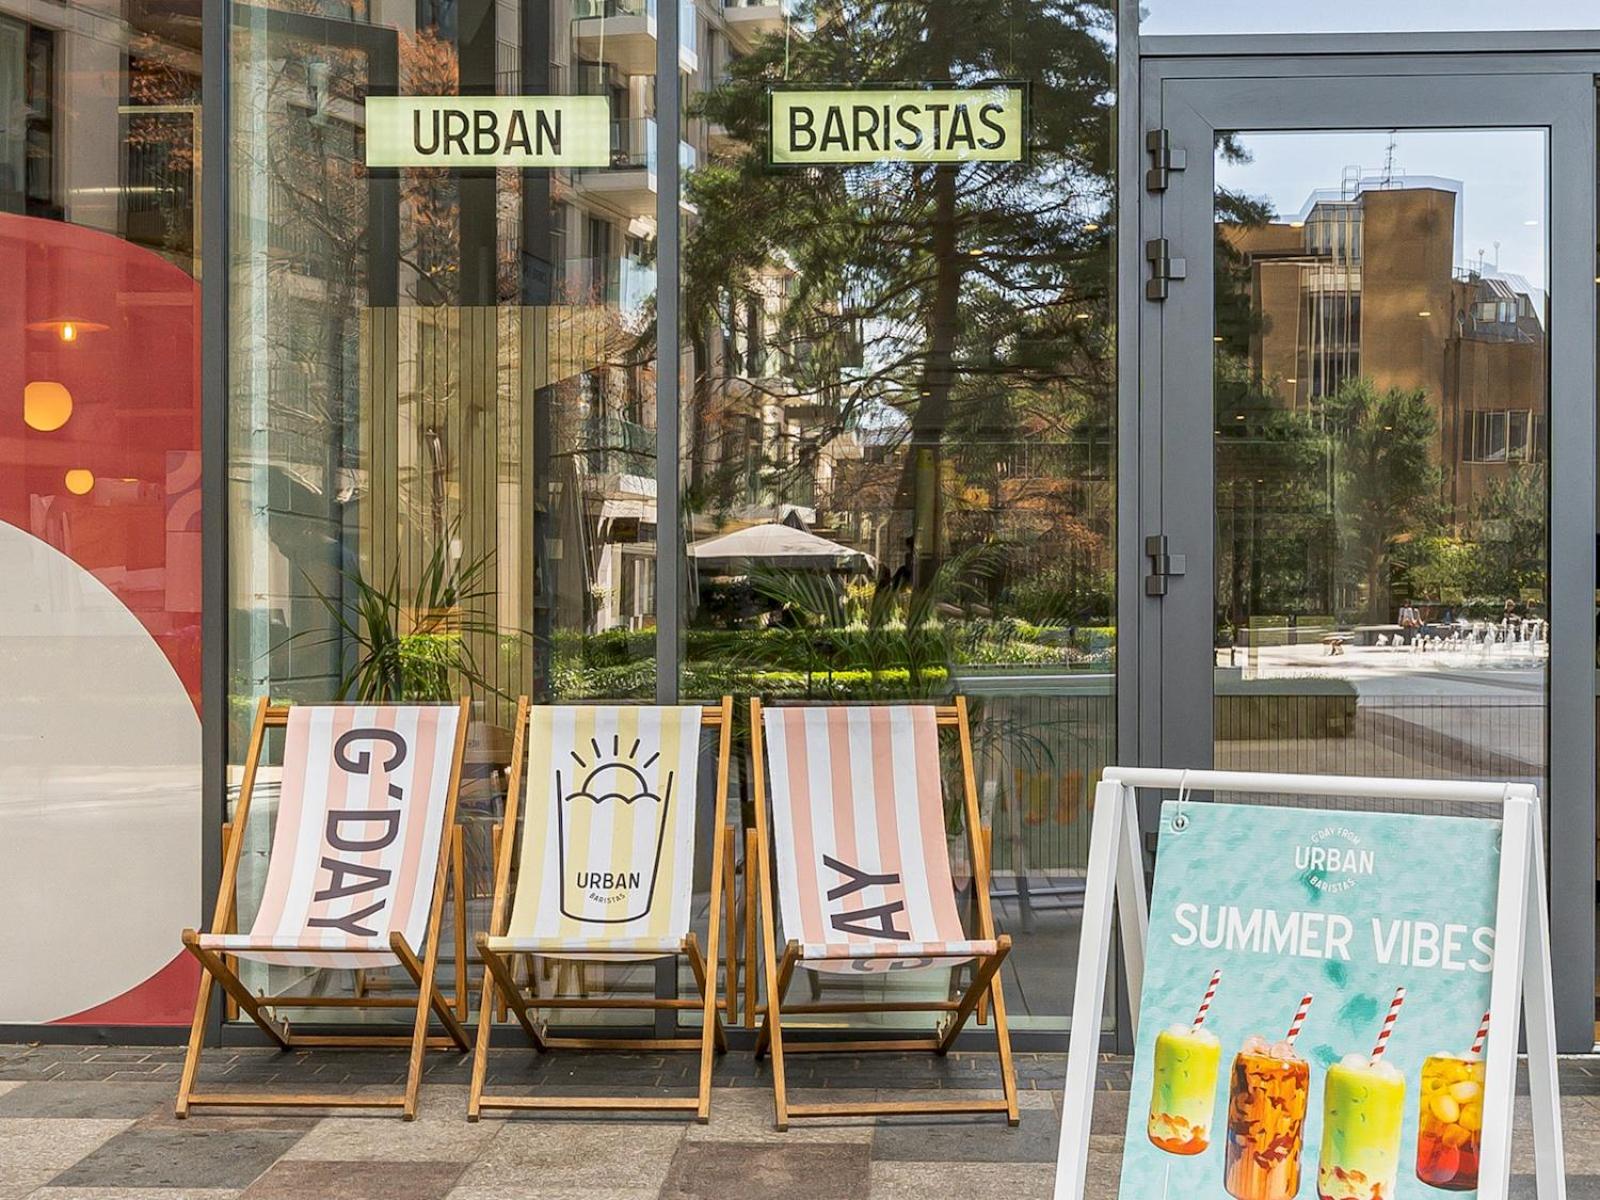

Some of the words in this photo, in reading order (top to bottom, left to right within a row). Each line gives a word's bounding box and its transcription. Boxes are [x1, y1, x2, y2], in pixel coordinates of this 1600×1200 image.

[413, 109, 562, 156] URBAN
[789, 104, 1006, 152] BARISTAS
[307, 728, 408, 937] G'DAY
[1337, 827, 1361, 845] FROM
[1295, 845, 1375, 875] URBAN
[576, 871, 641, 890] URBAN
[1309, 875, 1357, 893] BARISTAS
[588, 892, 626, 904] BARISTAS
[1171, 902, 1353, 961] SUMMER
[1371, 918, 1496, 973] VIBES
